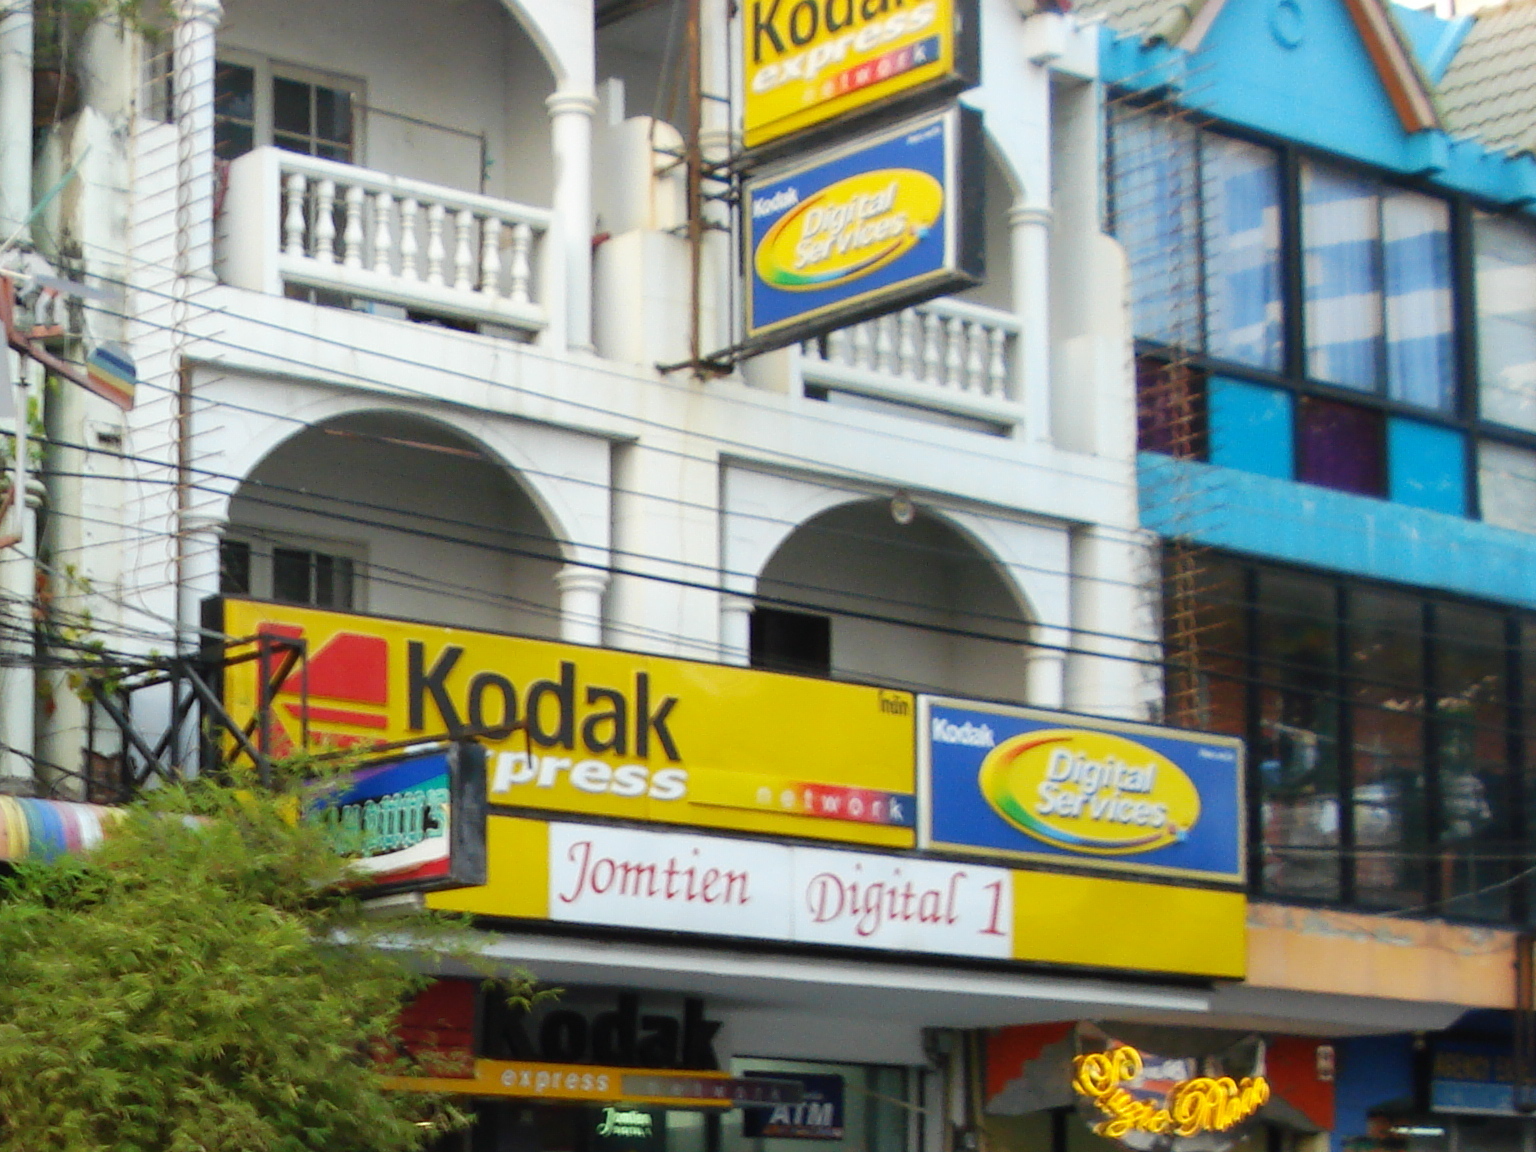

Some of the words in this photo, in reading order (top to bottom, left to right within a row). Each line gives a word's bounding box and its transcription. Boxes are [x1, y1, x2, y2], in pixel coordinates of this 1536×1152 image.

[752, 2, 937, 93] express
[752, 187, 800, 219] Kodak
[800, 181, 899, 239] Digital
[793, 212, 909, 271] Services
[407, 640, 682, 762] Kodak
[932, 717, 995, 748] Kodak
[485, 750, 689, 801] press
[1045, 747, 1159, 796] Digital
[756, 785, 905, 824] network
[1035, 781, 1170, 829] Services
[558, 840, 752, 906] Jomtien
[805, 861, 970, 938] Digital
[977, 879, 1007, 937] 1
[481, 986, 725, 1071] Kodak
[500, 1068, 610, 1093] express
[768, 1101, 834, 1127] ATM
